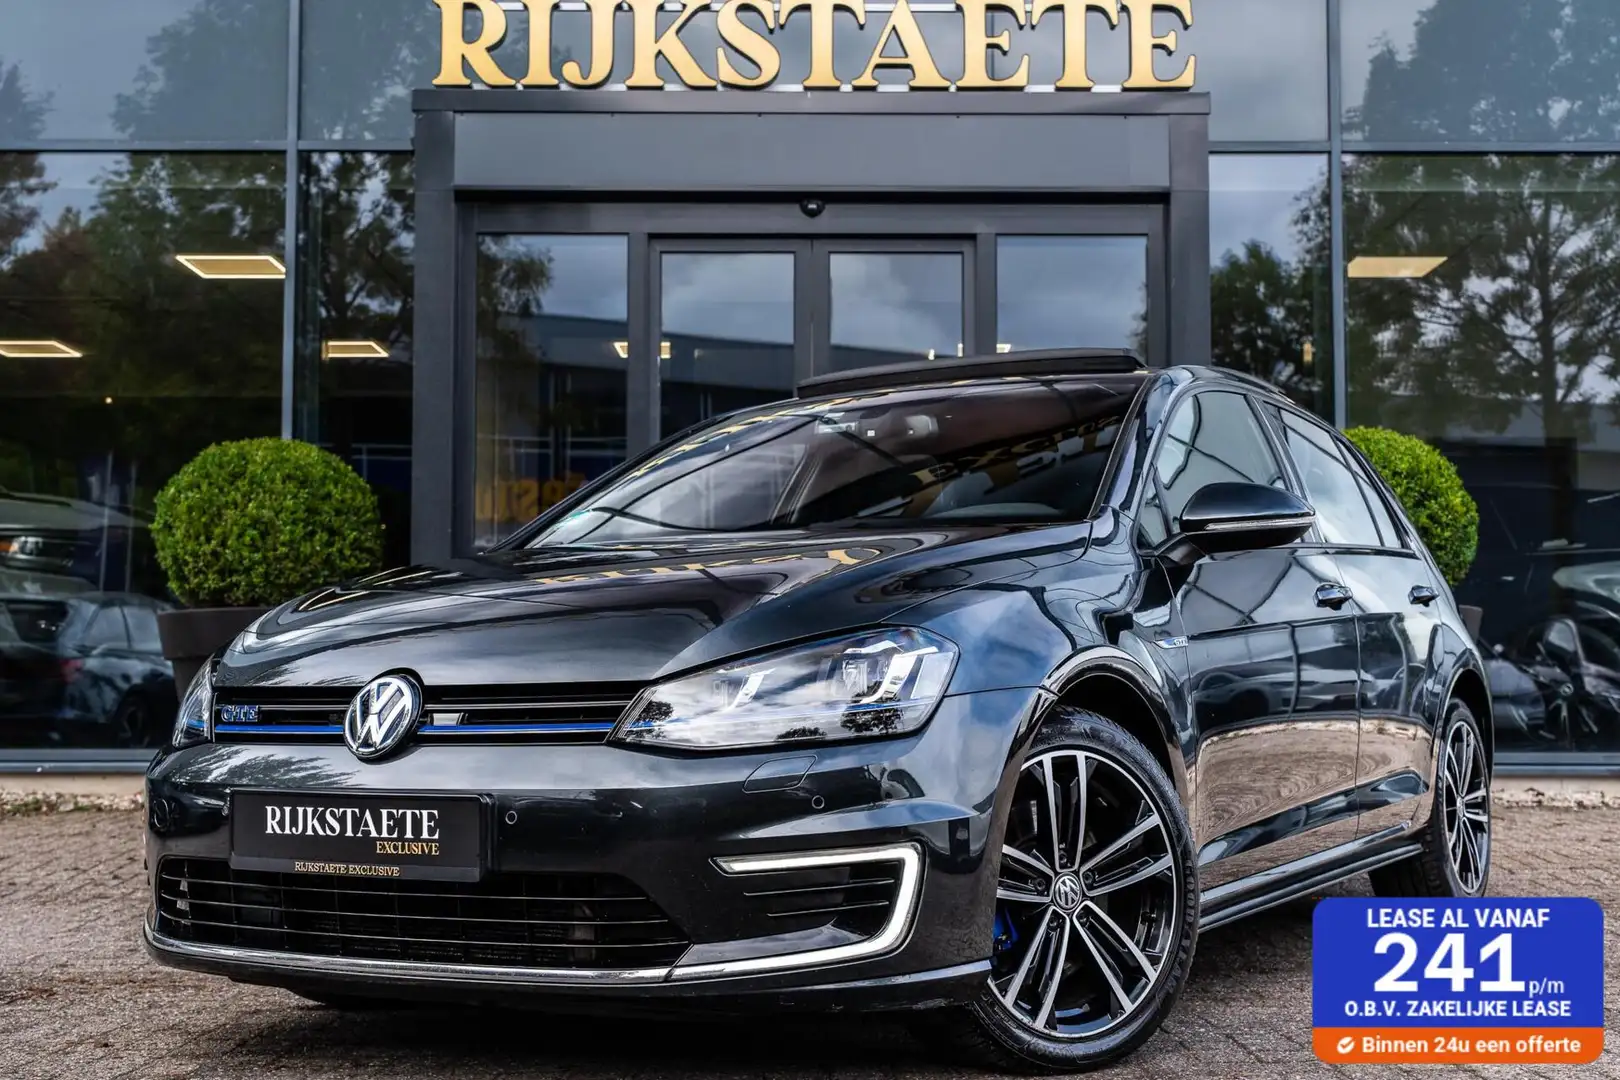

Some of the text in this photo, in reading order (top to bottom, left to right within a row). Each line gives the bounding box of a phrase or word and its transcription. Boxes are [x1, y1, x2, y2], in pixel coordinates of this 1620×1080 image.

[432, 0, 1197, 90] RIJKSTAETE
[220, 704, 259, 722] GTE
[264, 805, 440, 840] RIJKSTAETE
[376, 841, 440, 856] EXCLUSIVE
[294, 861, 400, 877] RIJKSTAETE EXCLUSIVE
